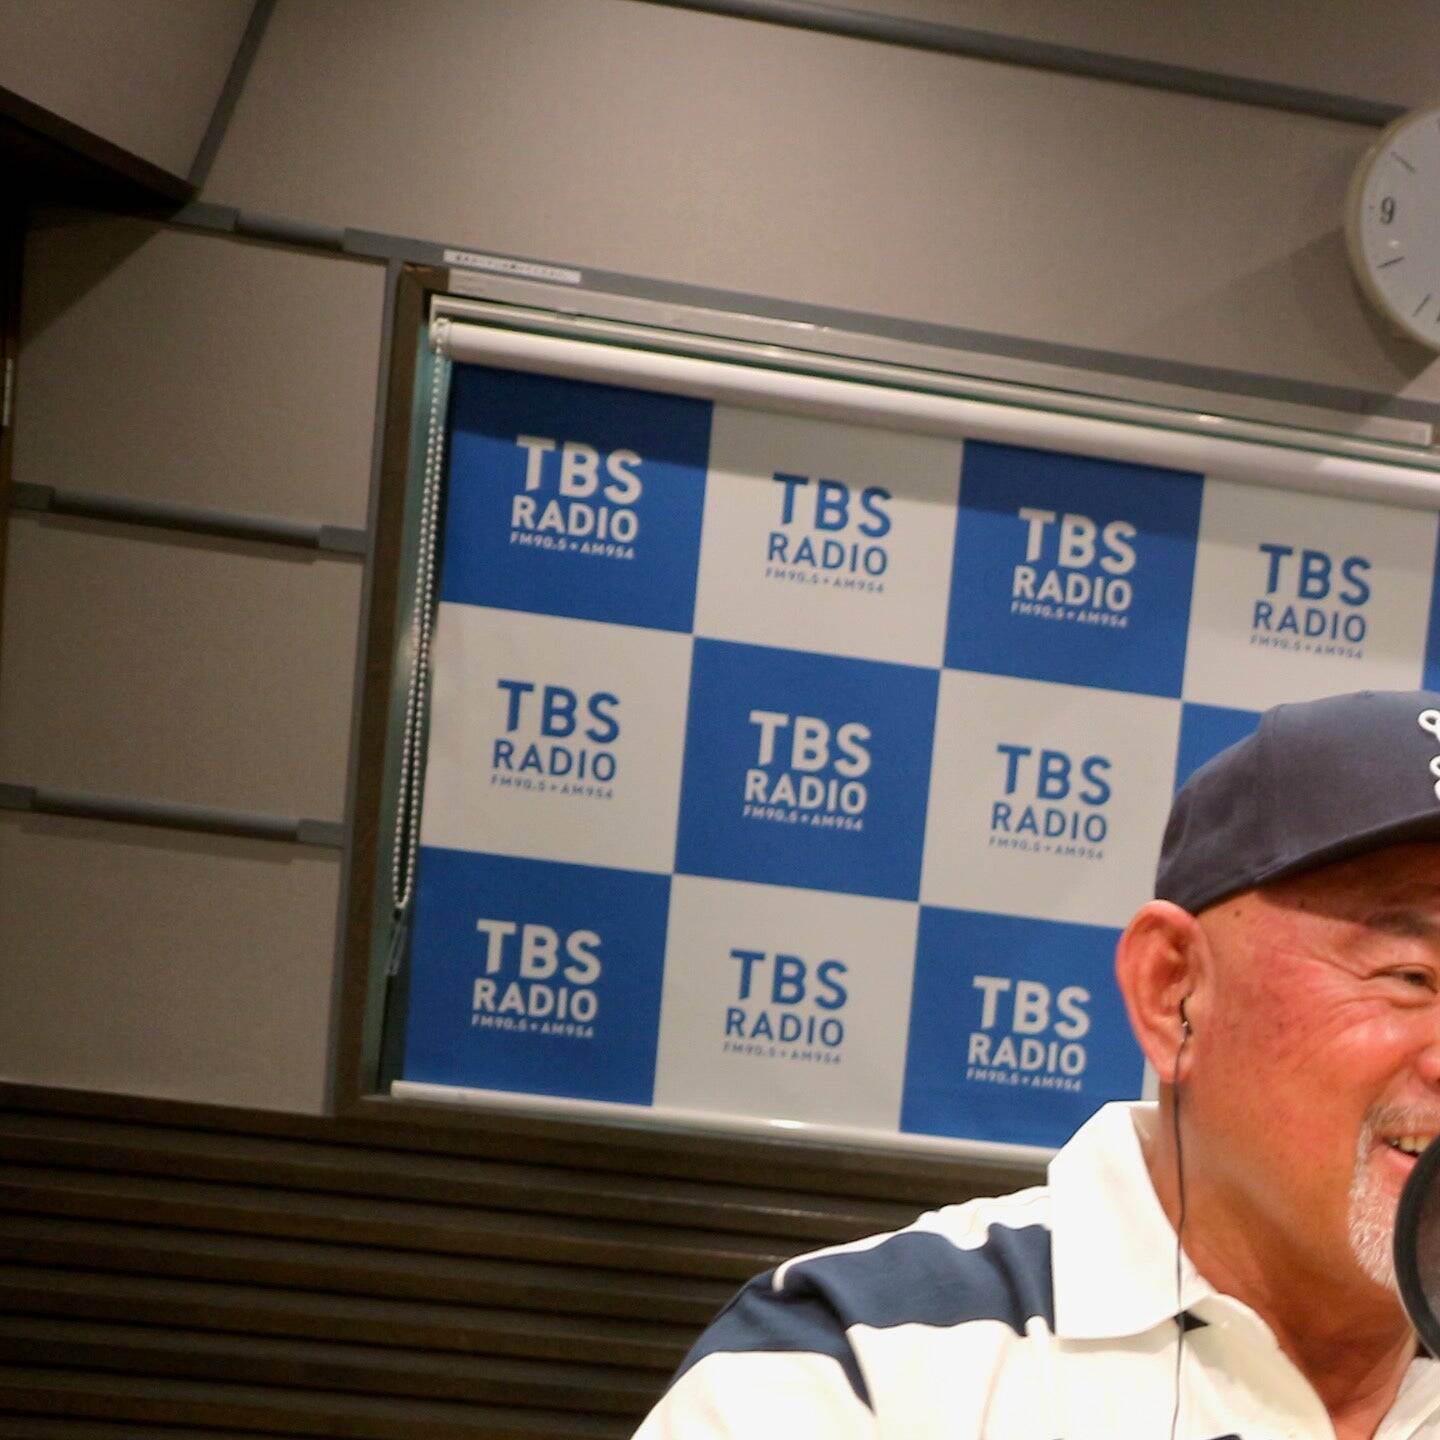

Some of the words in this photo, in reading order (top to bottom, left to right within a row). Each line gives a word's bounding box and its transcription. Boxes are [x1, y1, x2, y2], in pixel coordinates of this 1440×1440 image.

[1380, 196, 1396, 225] 9
[518, 435, 642, 504] TBS
[511, 496, 639, 544] RADIO
[774, 473, 893, 540] TBS
[768, 532, 889, 577] RADIO
[1019, 508, 1138, 575] TBS
[1013, 567, 1133, 612] RADIO
[1260, 543, 1373, 608] TBS
[1253, 600, 1368, 645] RADIO
[497, 679, 622, 745] TBS
[491, 738, 618, 783] RADIO
[749, 710, 873, 779] TBS
[745, 770, 869, 815] RADIO
[996, 743, 1113, 807] TBS
[990, 801, 1109, 844] RADIO
[476, 918, 603, 986] TBS
[471, 978, 600, 1023] RADIO
[729, 948, 850, 1012] TBS
[724, 1007, 846, 1049] RADIO
[972, 975, 1092, 1041] TBS
[967, 1033, 1088, 1077] RADIO
